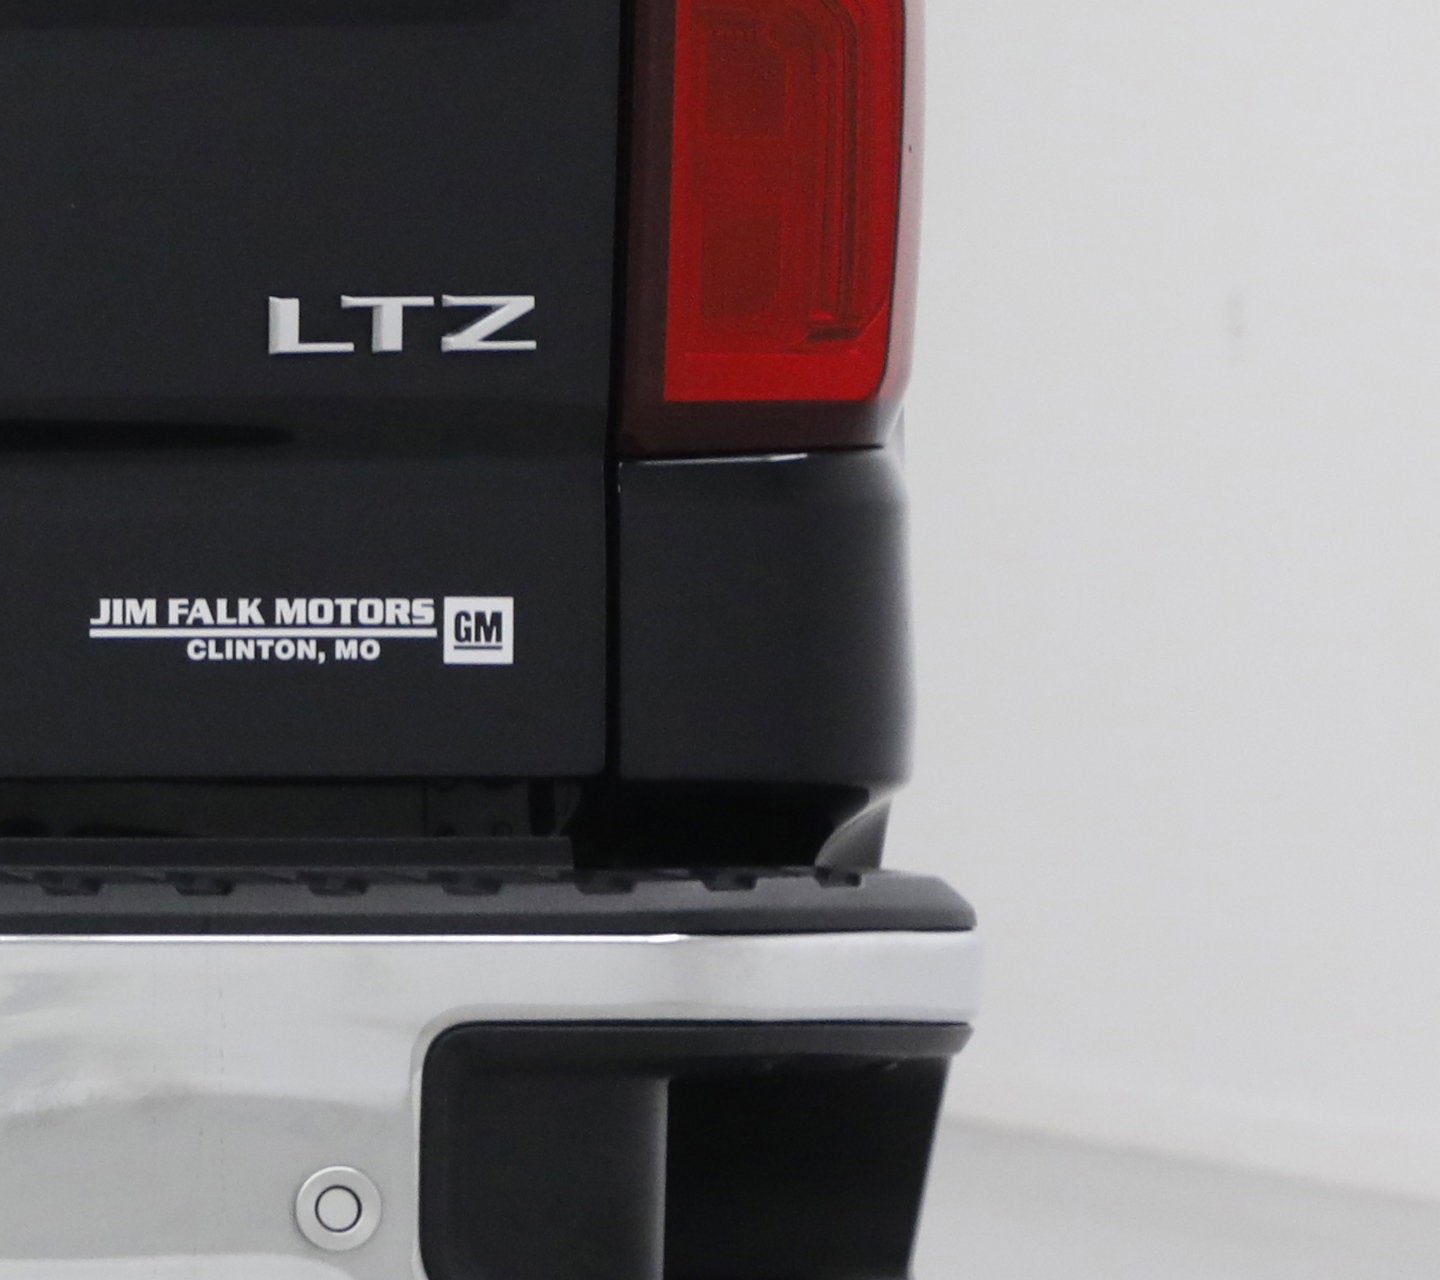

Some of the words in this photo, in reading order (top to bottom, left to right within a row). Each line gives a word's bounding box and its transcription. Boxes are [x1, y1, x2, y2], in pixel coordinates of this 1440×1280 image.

[268, 295, 536, 354] LTZ
[90, 598, 156, 626] JIM
[168, 598, 265, 626] FALK
[275, 598, 435, 626] MOTORS
[453, 609, 503, 645] GM
[186, 639, 327, 664] CLINTON,
[335, 639, 381, 661] MO
